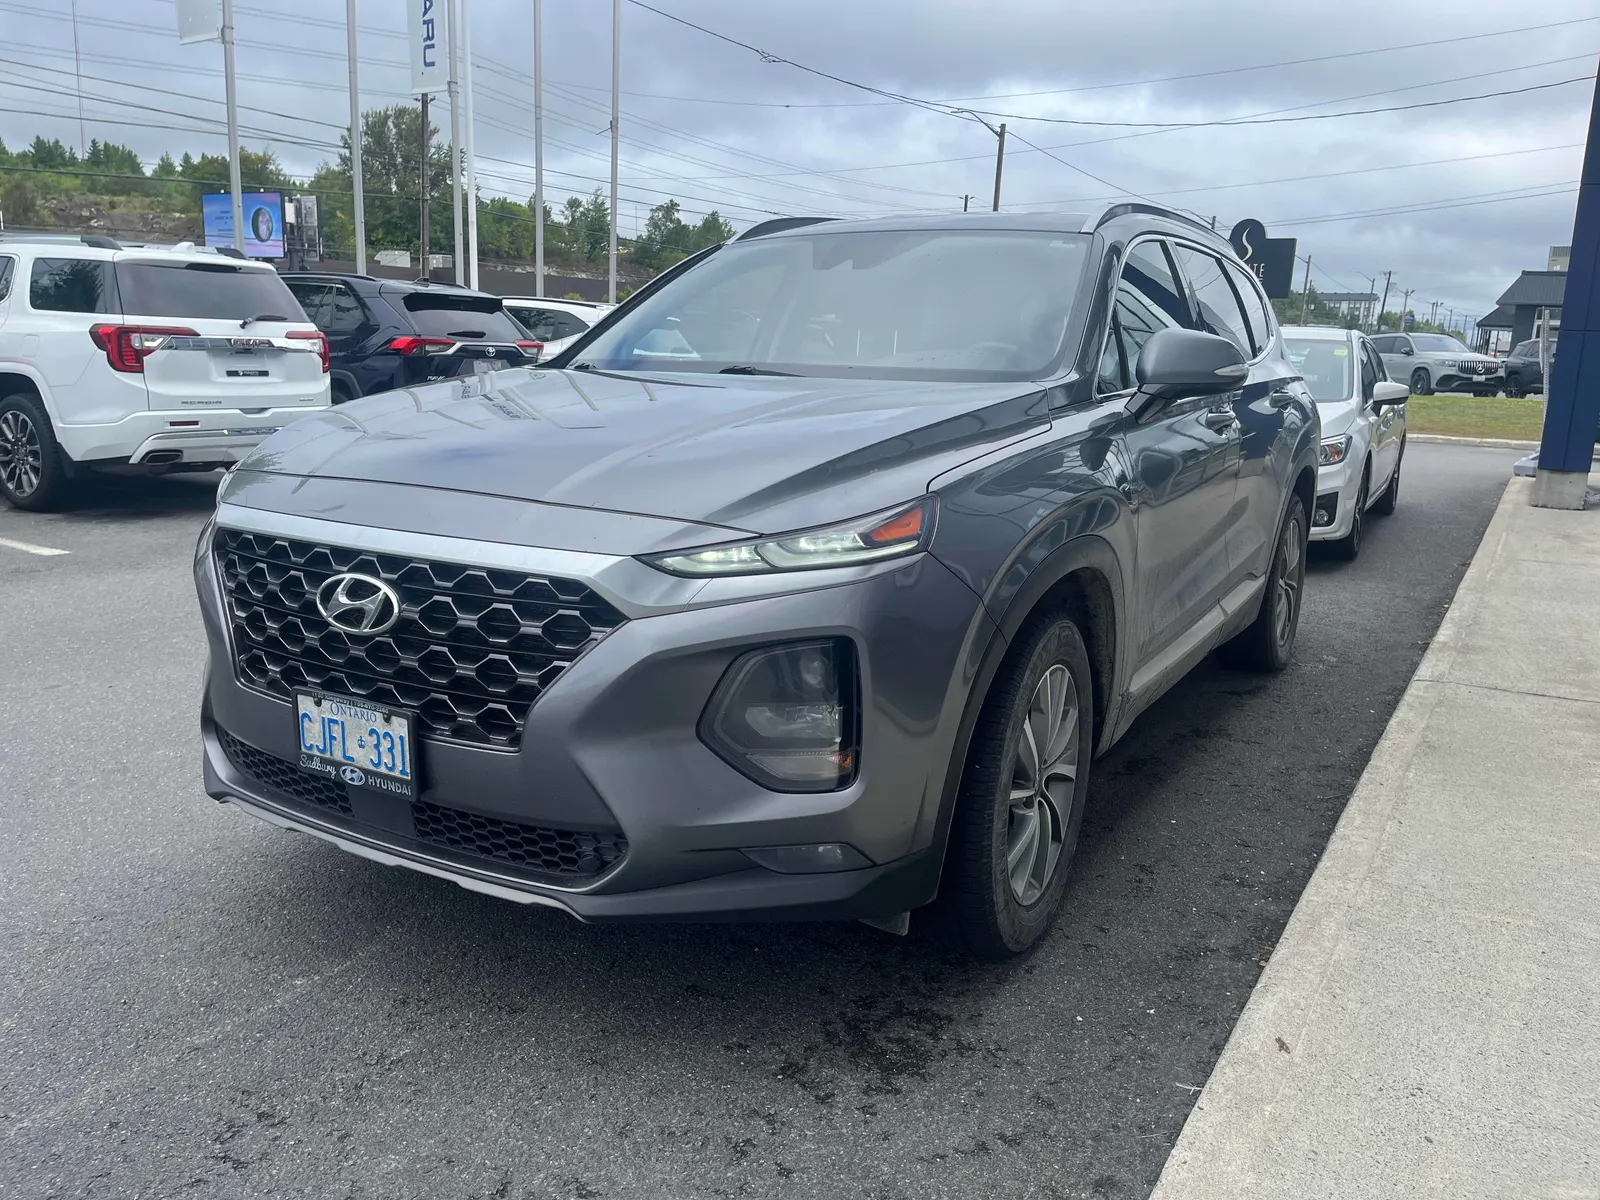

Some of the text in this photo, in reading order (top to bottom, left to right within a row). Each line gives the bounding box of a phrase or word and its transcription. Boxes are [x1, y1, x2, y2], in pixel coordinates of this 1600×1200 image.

[330, 702, 377, 723] ONTARIO
[300, 711, 409, 777] CJFL 331
[300, 754, 412, 797] Sudbury HYUNDAI
